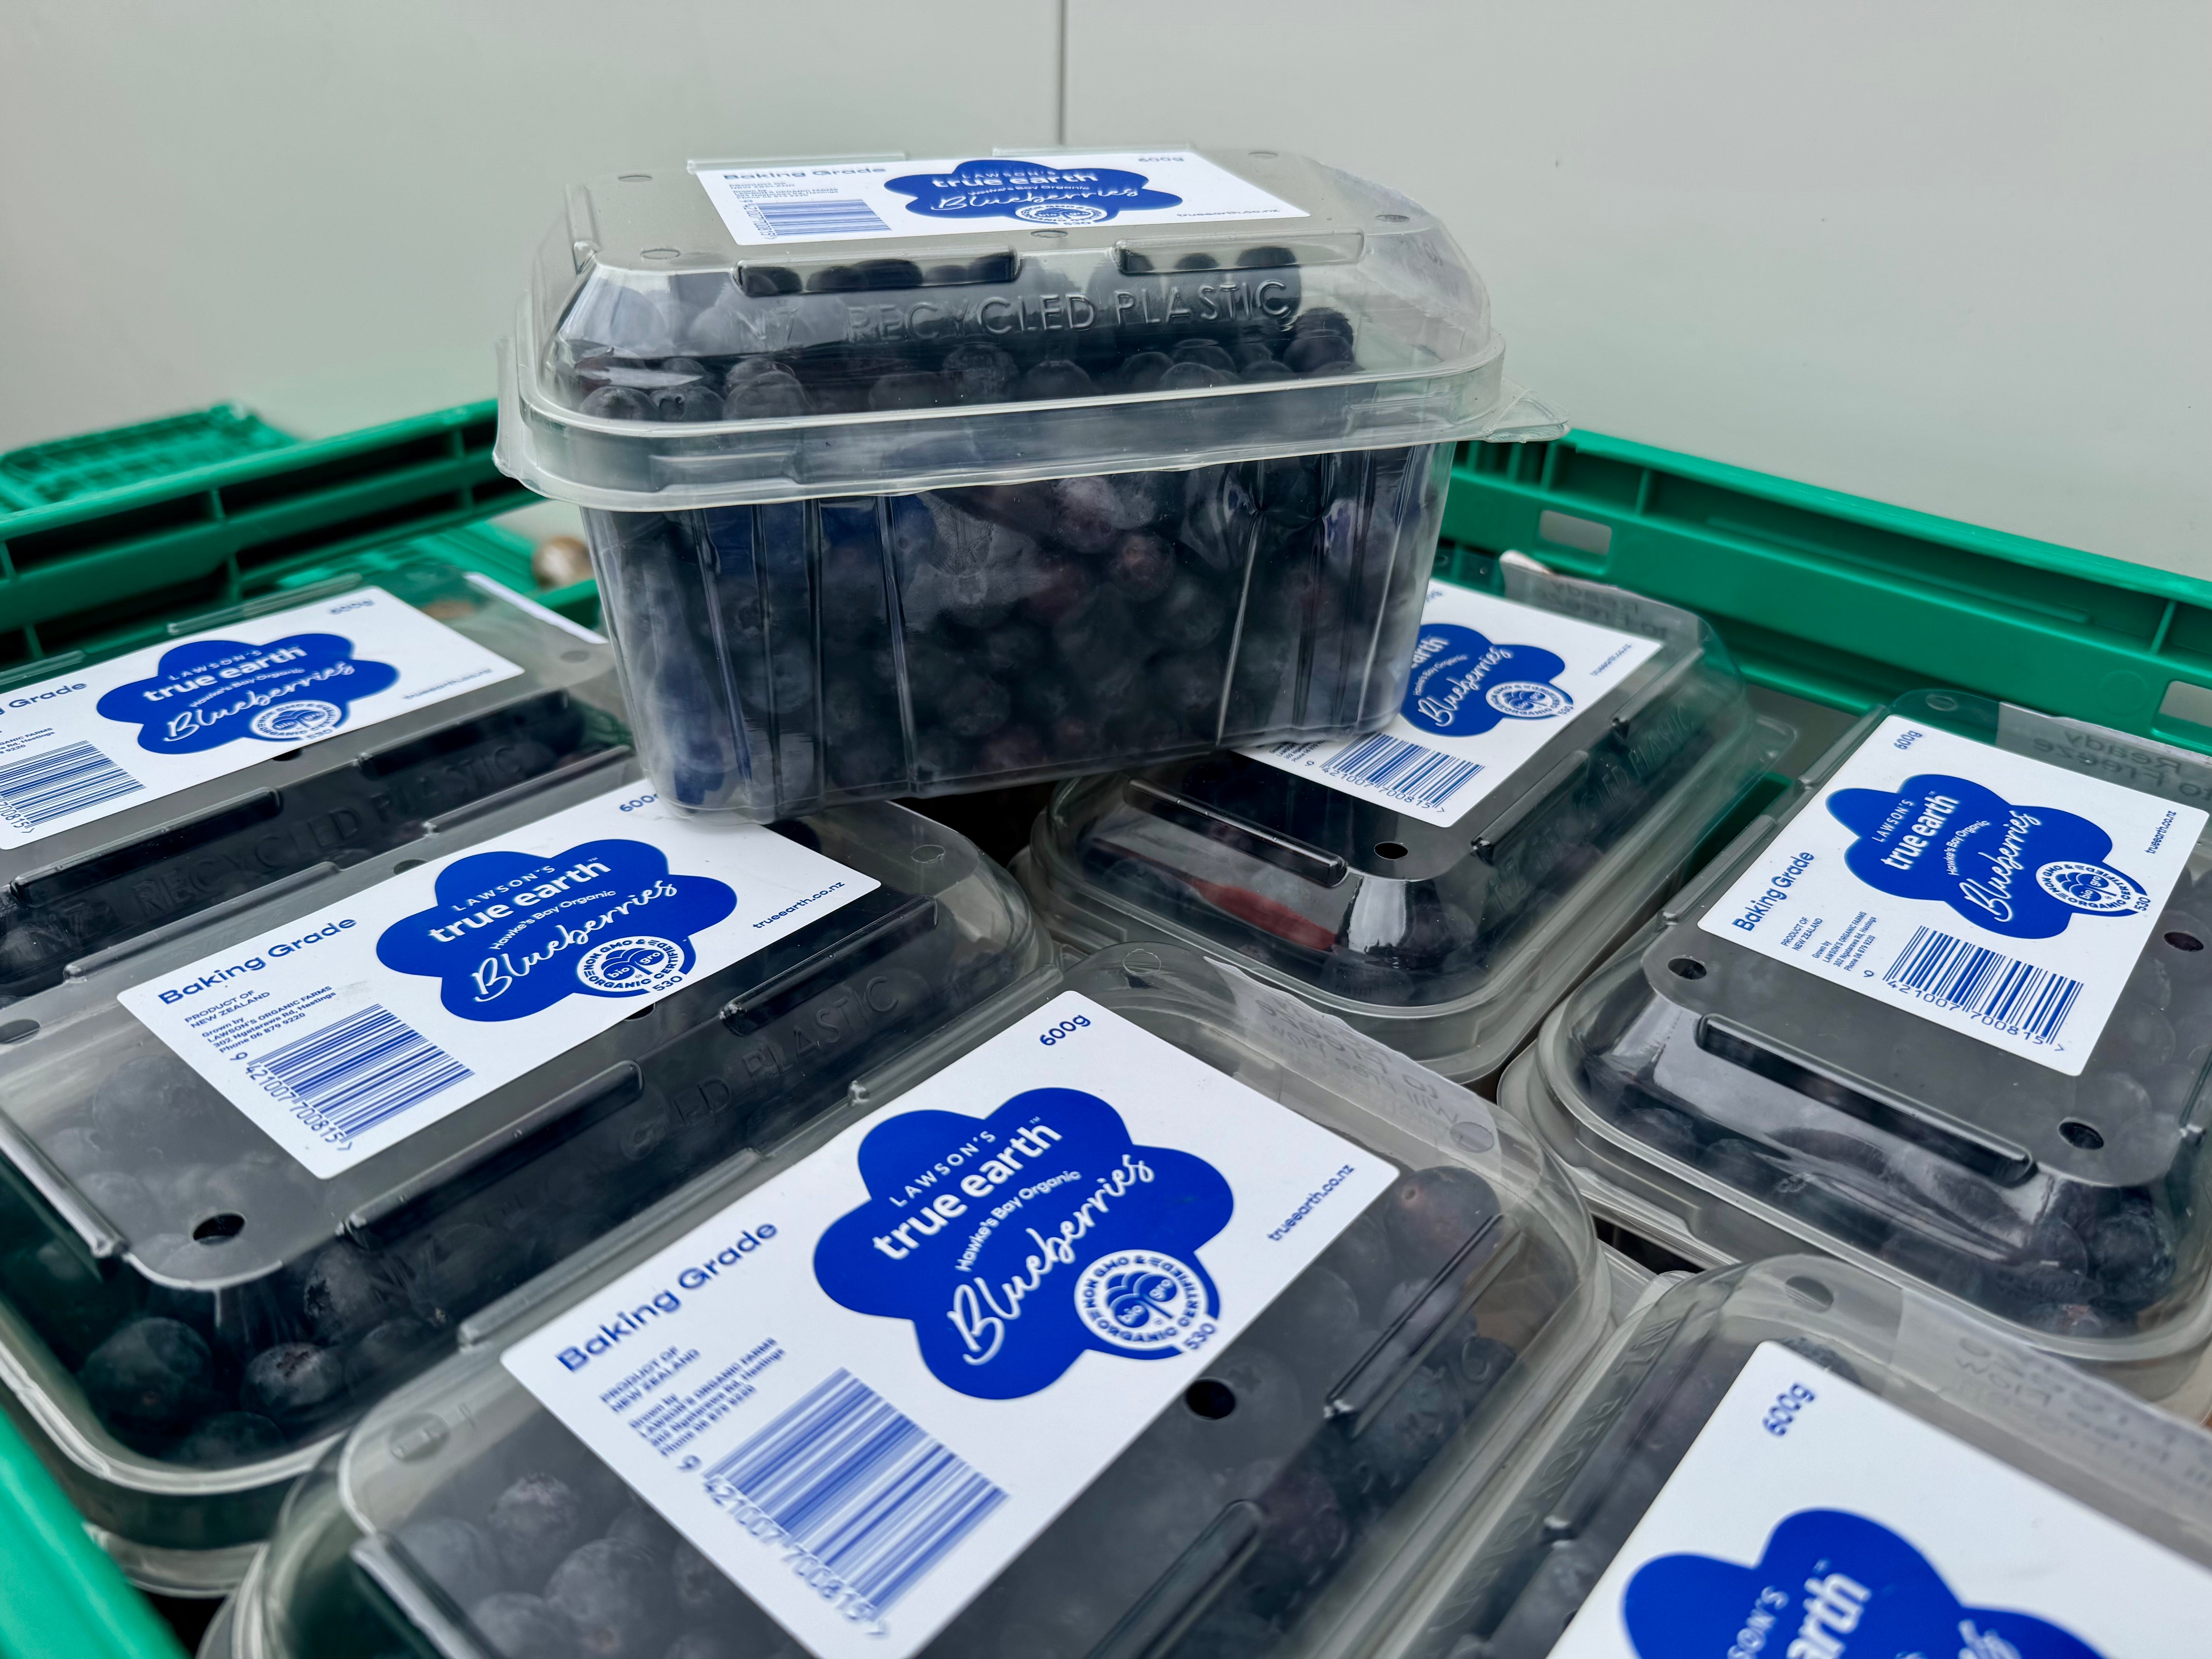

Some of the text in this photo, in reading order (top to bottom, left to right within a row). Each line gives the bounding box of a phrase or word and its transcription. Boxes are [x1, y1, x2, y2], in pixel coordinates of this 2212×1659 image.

[812, 167, 887, 176] Grade
[932, 173, 1098, 187] true earth
[931, 189, 1138, 210] Blueberries
[846, 279, 1291, 343] RECYCLED PLASTIC
[144, 649, 307, 701] true earth
[170, 650, 261, 680] LAWSON'S
[1418, 648, 1512, 726] Blueberries
[8, 683, 88, 708] Grade
[164, 663, 354, 742] Blueberries
[25, 727, 53, 737] FARMS
[1894, 730, 1923, 750] 600g
[619, 793, 659, 812] 600
[1321, 767, 1374, 787] 421007
[1378, 787, 1433, 809] 700815
[1872, 799, 1914, 842] LAWSON'S
[1881, 795, 1959, 870] true earth
[2145, 811, 2177, 854] trueearth.co.nz
[1943, 821, 1990, 876] Hawke's Bay Organic
[1959, 810, 2041, 922] Blueberries
[453, 866, 554, 912] LAWSON'S
[1732, 852, 1814, 931] Baking Grade
[2042, 865, 2064, 877] GMO
[2042, 877, 2061, 893] NON
[2068, 867, 2131, 909] ORGANIC CERTIFIED
[2079, 876, 2101, 900] bio gro
[430, 862, 610, 942] true earth
[490, 890, 616, 950] Hawke's Bay Organic
[752, 881, 845, 928] trueearth.co.nz
[2134, 896, 2151, 911] 530
[472, 880, 676, 1002] Blueberries
[1781, 917, 1808, 946] PRODUCT OF
[1791, 918, 1823, 951] NEW ZEALAND
[1812, 946, 1827, 958] Grown
[1822, 911, 1867, 963] LAWSON'S ORGANIC FARMS
[1833, 958, 1844, 967] 302
[1839, 939, 1860, 960] Ngatarawa
[1859, 916, 1877, 933] Hastings
[1843, 958, 1858, 972] Phone
[1857, 945, 1868, 953] 879
[1863, 935, 1875, 946] 9220
[158, 919, 357, 1004] Baking Grade
[582, 952, 602, 970] NON
[600, 940, 633, 952] GMO
[587, 942, 679, 989] ORGANIC CERTIFIED
[607, 952, 661, 978] bio gro
[652, 975, 683, 991] 530
[184, 990, 254, 1023] PRODUCT OF
[190, 992, 270, 1028] NEW ZEALAND
[207, 986, 332, 1042] LAWSON'S ORGANIC FARMS
[213, 1037, 232, 1048] 302
[297, 992, 337, 1010] Hastings
[742, 975, 899, 1079] PLASTIC
[1887, 980, 1960, 1011] 421007
[1970, 1011, 2045, 1044] 700815
[201, 1023, 232, 1037] Grown
[219, 1038, 249, 1053] Phone
[263, 1023, 281, 1033] 879
[282, 1013, 306, 1024] 9220
[1040, 1014, 1092, 1046] 600g
[246, 1065, 297, 1101] 421007
[289, 1102, 345, 1142] 700815
[890, 1131, 995, 1207] LAWSON'S
[873, 1125, 1062, 1259] true earth
[1268, 1164, 1355, 1241] trueearth.co.nz
[956, 1171, 1081, 1271] Hawke's Bay Organic
[948, 1154, 1154, 1364] Blueberries
[554, 1223, 778, 1374] Baking Grade
[1118, 1279, 1172, 1324] bio gro
[1096, 1319, 1179, 1344] ORGANIC
[1183, 1323, 1216, 1350] 530
[1763, 1383, 1816, 1436] 600g
